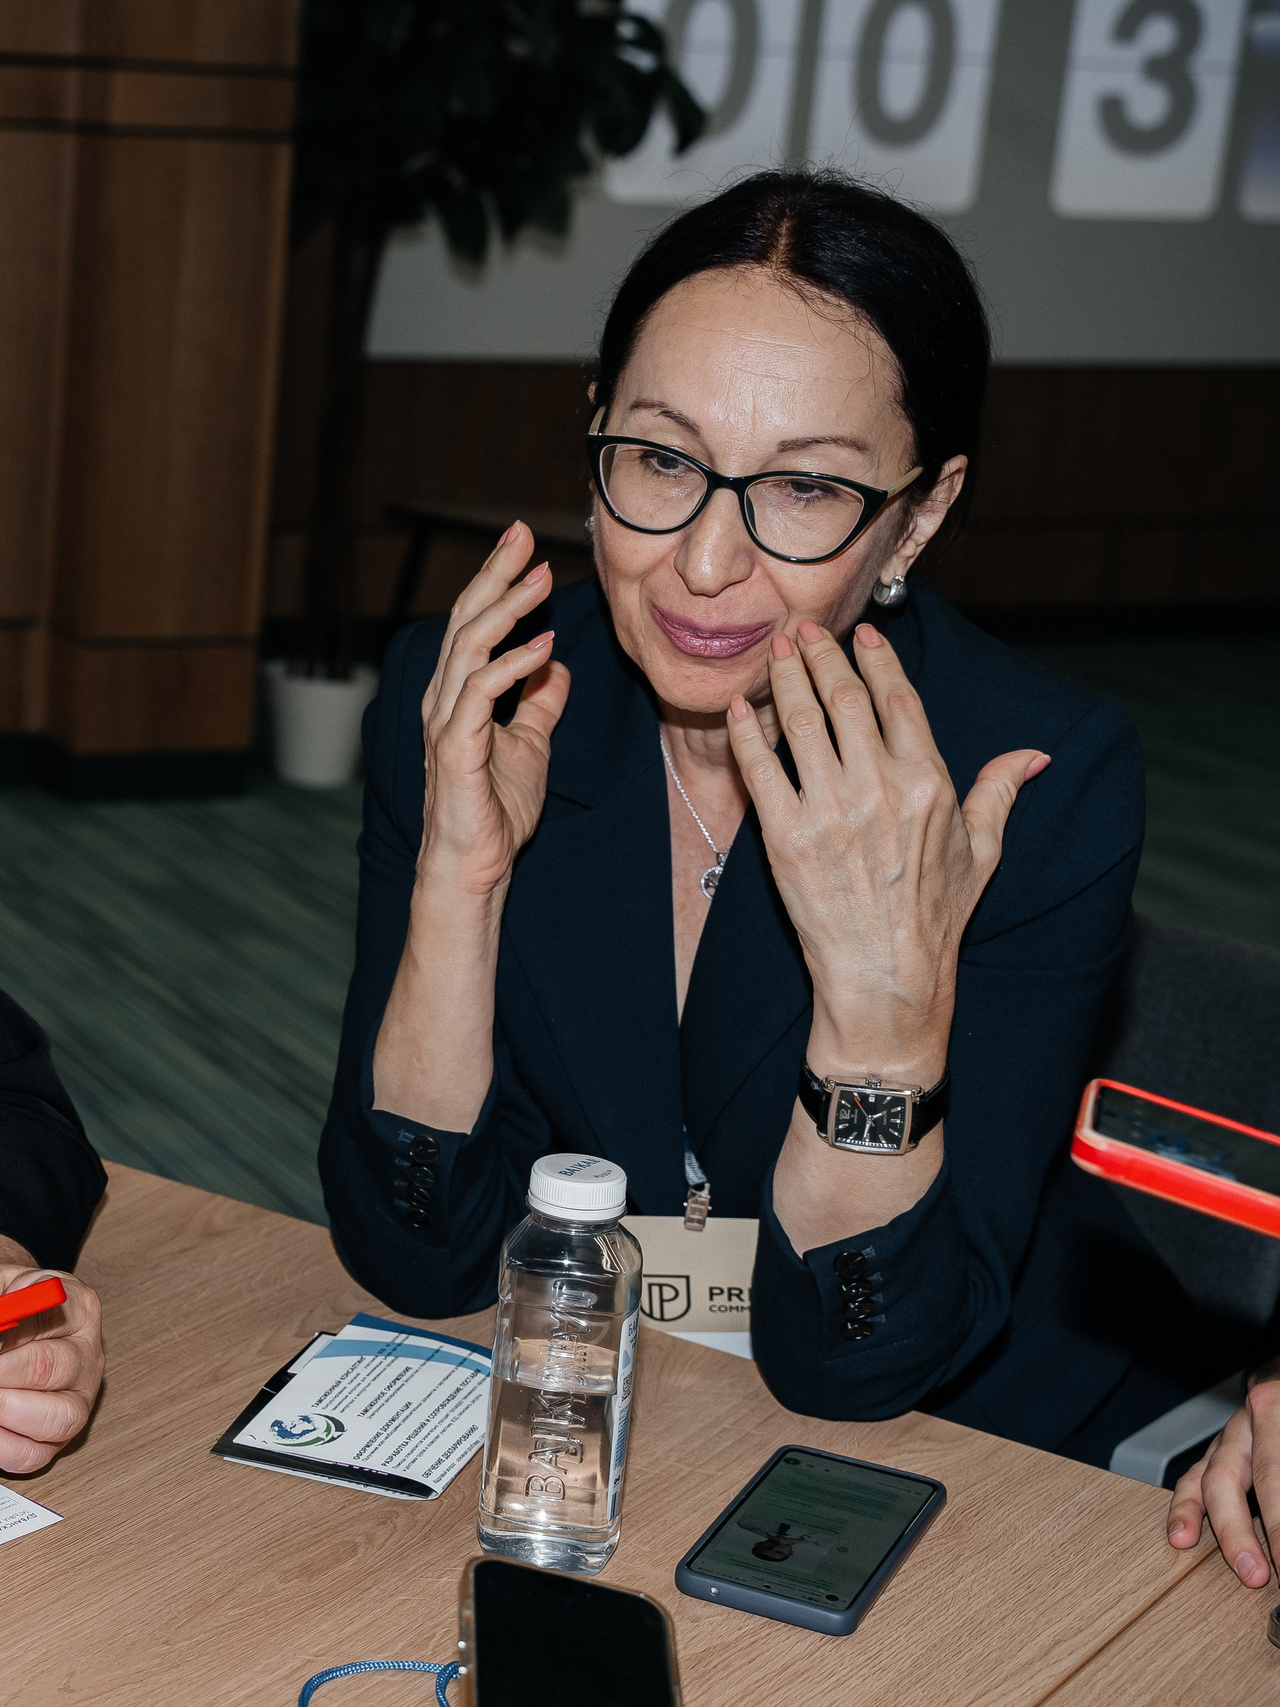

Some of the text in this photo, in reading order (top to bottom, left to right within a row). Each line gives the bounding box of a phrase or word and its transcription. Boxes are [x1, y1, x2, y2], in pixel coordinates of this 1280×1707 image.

[353, 1430, 382, 1460] ОФОРМЛЕНИЕ
[381, 1440, 409, 1467] РАЗРАБОТКА
[405, 1420, 427, 1441] РЕШЕНИЙ
[421, 1456, 444, 1478] ОБУЧЕНИЕ
